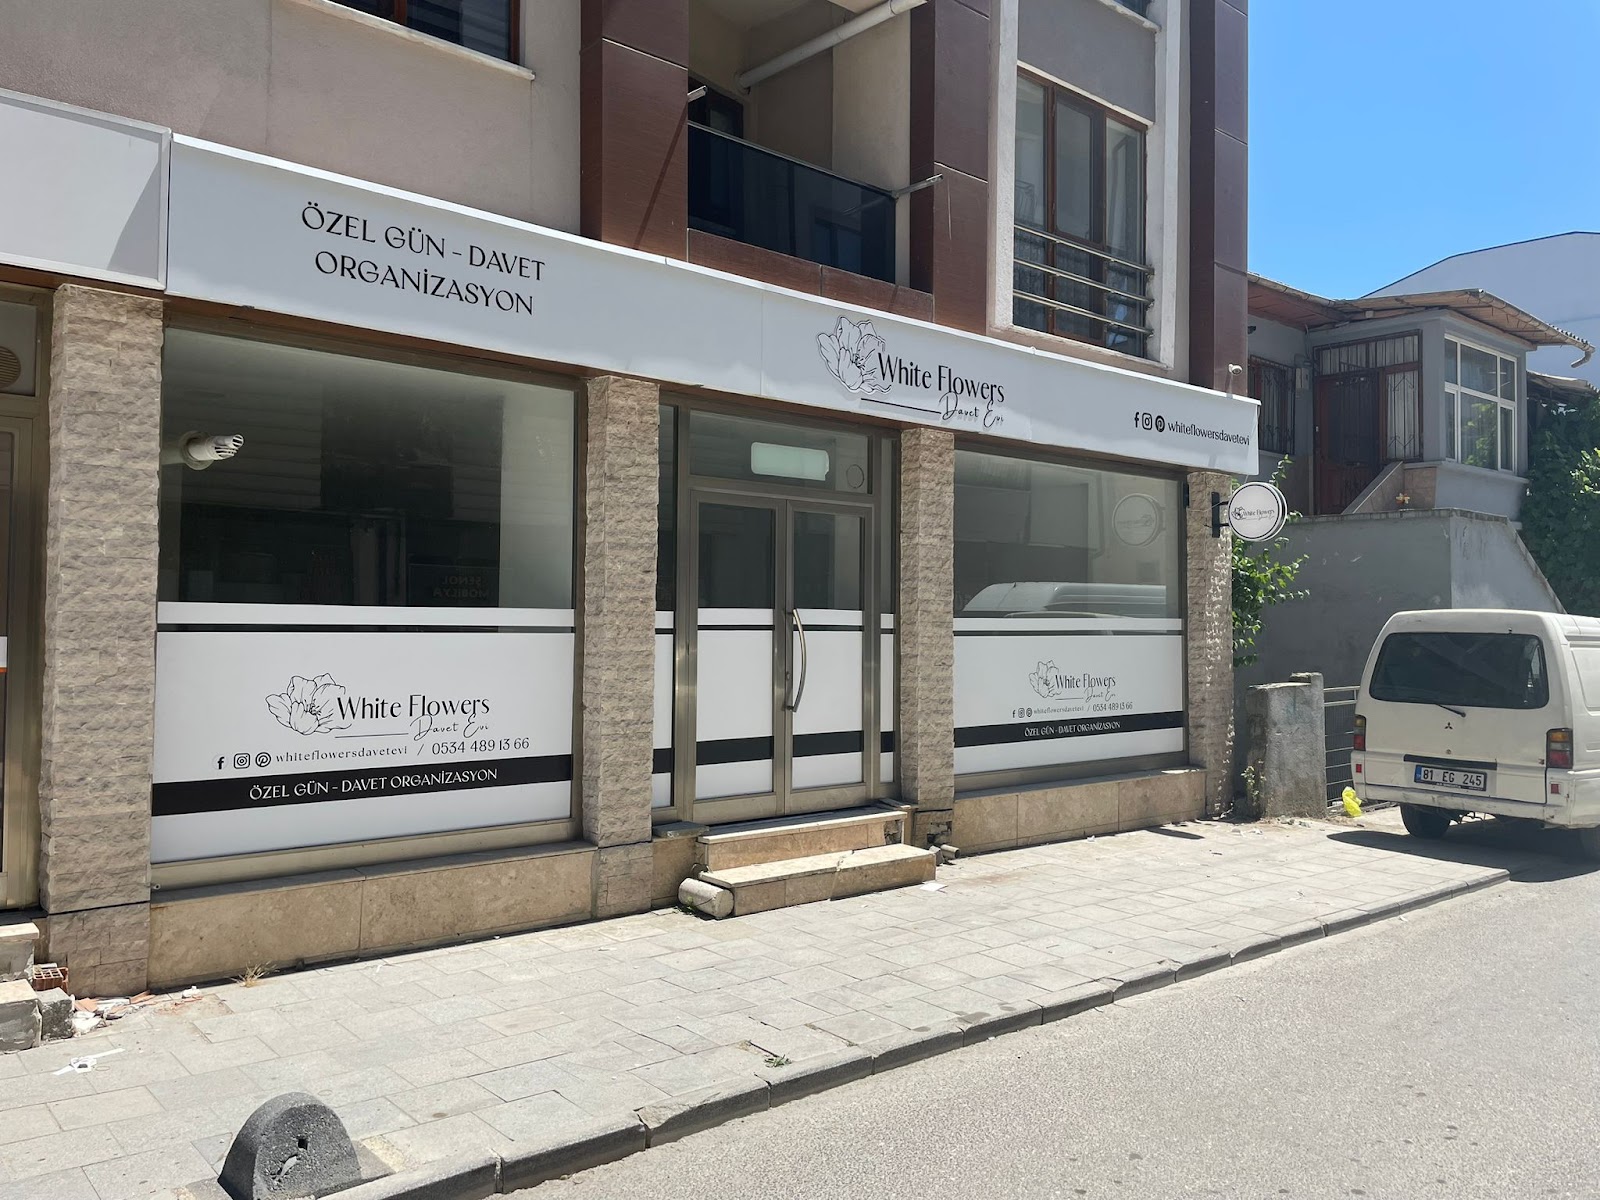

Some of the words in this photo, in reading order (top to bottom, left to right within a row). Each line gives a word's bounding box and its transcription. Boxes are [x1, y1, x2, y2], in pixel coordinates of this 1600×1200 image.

[301, 201, 376, 243] ÖZEL
[384, 226, 445, 258] GÜN
[468, 245, 546, 281] DAVET
[315, 251, 534, 316] ORGANİZASYON
[877, 352, 932, 389] White
[938, 364, 1005, 403] Flowers
[938, 391, 979, 421] Davet
[1167, 421, 1250, 446] whiteflowersdavetevi
[1055, 674, 1081, 689] White
[1083, 673, 1116, 689] Flowers
[336, 696, 402, 720] White
[408, 694, 490, 717] Flowers
[1092, 703, 1107, 712] 0534
[1107, 702, 1119, 711] 489
[1125, 701, 1133, 710] 66
[410, 714, 459, 741] Davet
[1024, 727, 1040, 737] ÖZEL
[1041, 726, 1055, 736] GÜN
[1058, 724, 1077, 734] DAVET
[1077, 721, 1121, 732] ORGANİZASYON
[276, 745, 408, 763] whiteflowersdavetevi
[431, 741, 466, 755] 0534
[469, 739, 496, 753] 489
[498, 738, 511, 751] 13
[513, 737, 530, 750] 66
[249, 784, 290, 800] ÖZEL
[293, 780, 329, 797] GÜN
[341, 777, 387, 793] DAVET
[390, 768, 498, 788] ORGANİZASYON
[1423, 769, 1434, 781] 81
[1442, 771, 1455, 783] EG
[1463, 774, 1482, 786] 245
